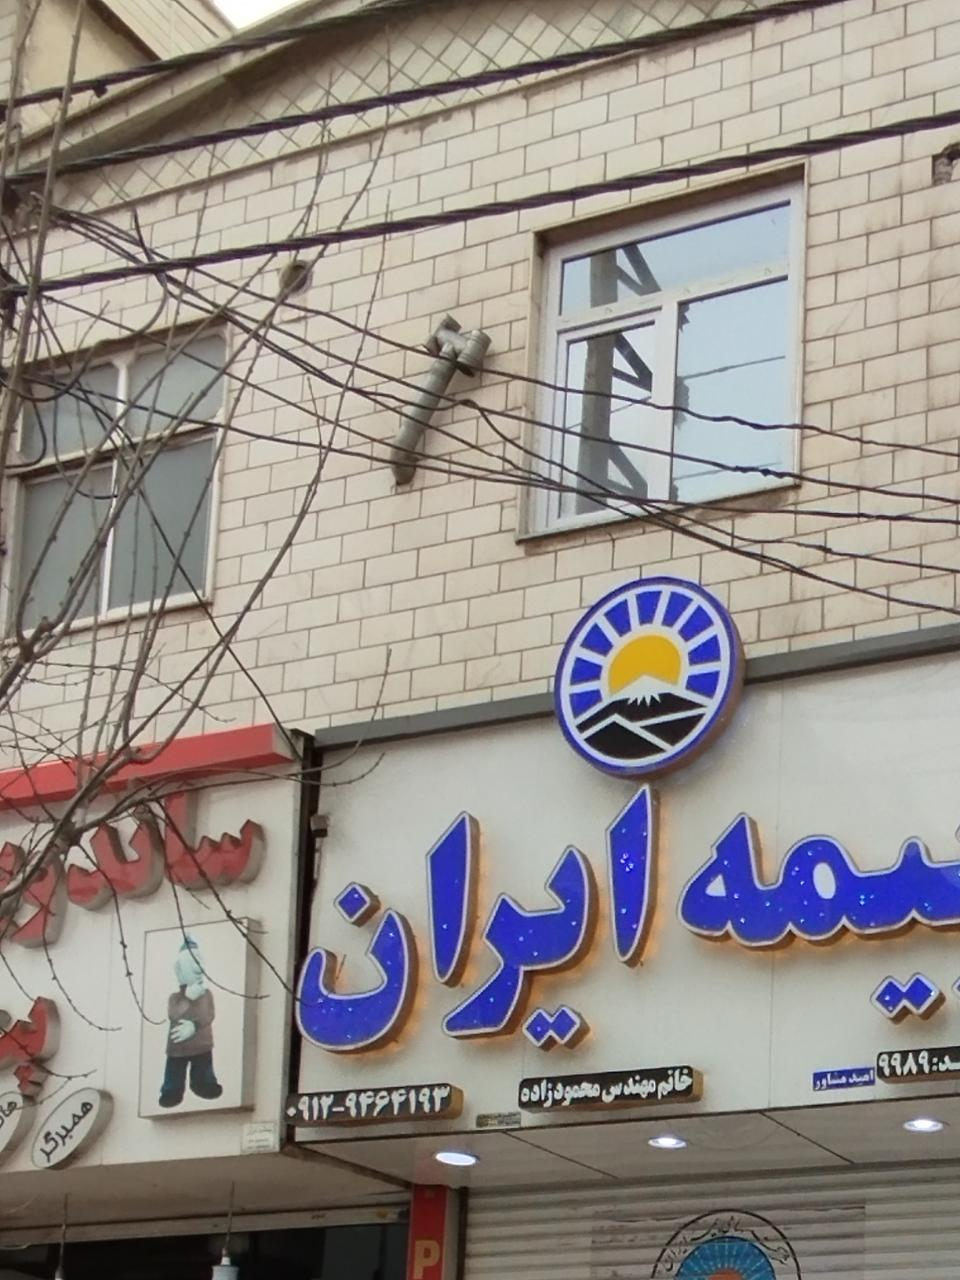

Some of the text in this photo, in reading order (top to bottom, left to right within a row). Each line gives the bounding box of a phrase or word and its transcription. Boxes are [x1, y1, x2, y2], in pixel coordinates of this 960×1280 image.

[297, 784, 656, 1051] ایران
[602, 1075, 657, 1102] مهندس
[658, 1068, 694, 1099] خانم
[40, 1101, 94, 1163] همبرگر
